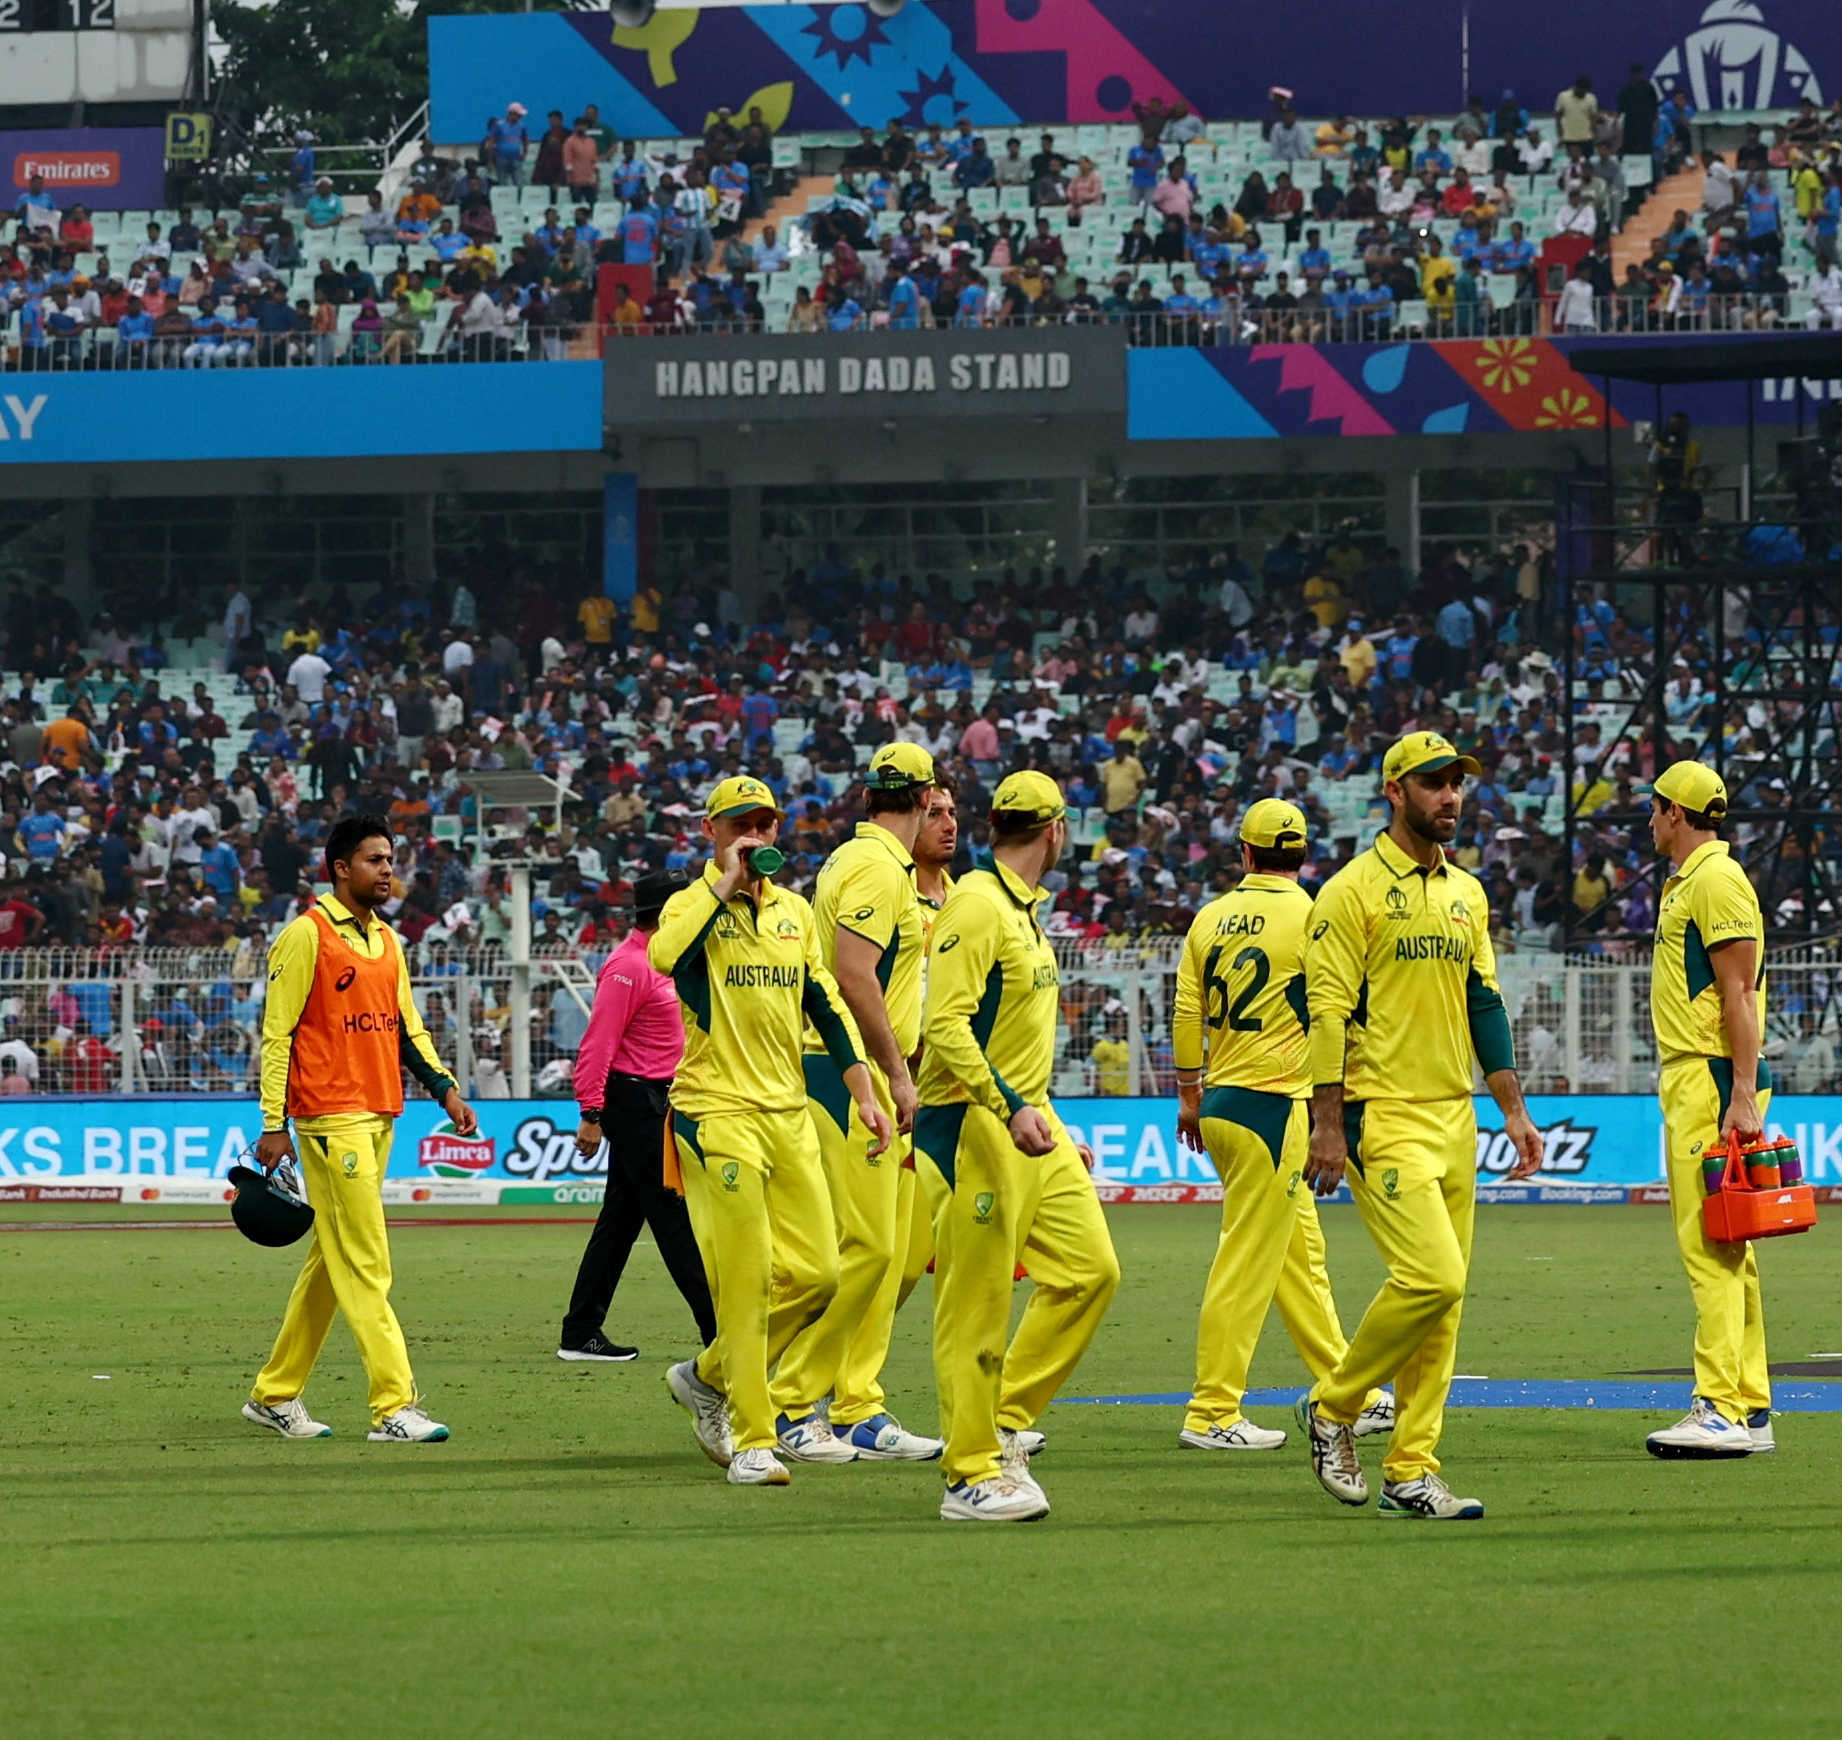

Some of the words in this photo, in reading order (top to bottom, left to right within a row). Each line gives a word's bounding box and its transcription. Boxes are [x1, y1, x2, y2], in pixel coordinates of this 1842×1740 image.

[24, 160, 110, 179] Emirates
[655, 357, 826, 398] HANGPAN
[837, 355, 937, 394] DADA
[950, 351, 1072, 391] STAND
[1215, 914, 1265, 935] HEAD
[1711, 920, 1754, 933] HCLTech
[1395, 935, 1467, 965] AUSTRALI
[725, 965, 798, 987] AUSTRALIA
[1203, 945, 1270, 1032] 62
[83, 1126, 256, 1180] BREA
[422, 1141, 491, 1162] Limca
[90, 1188, 119, 1200] Bank
[1131, 1186, 1186, 1200] MRF
[1539, 1188, 1623, 1202] Booking.com
